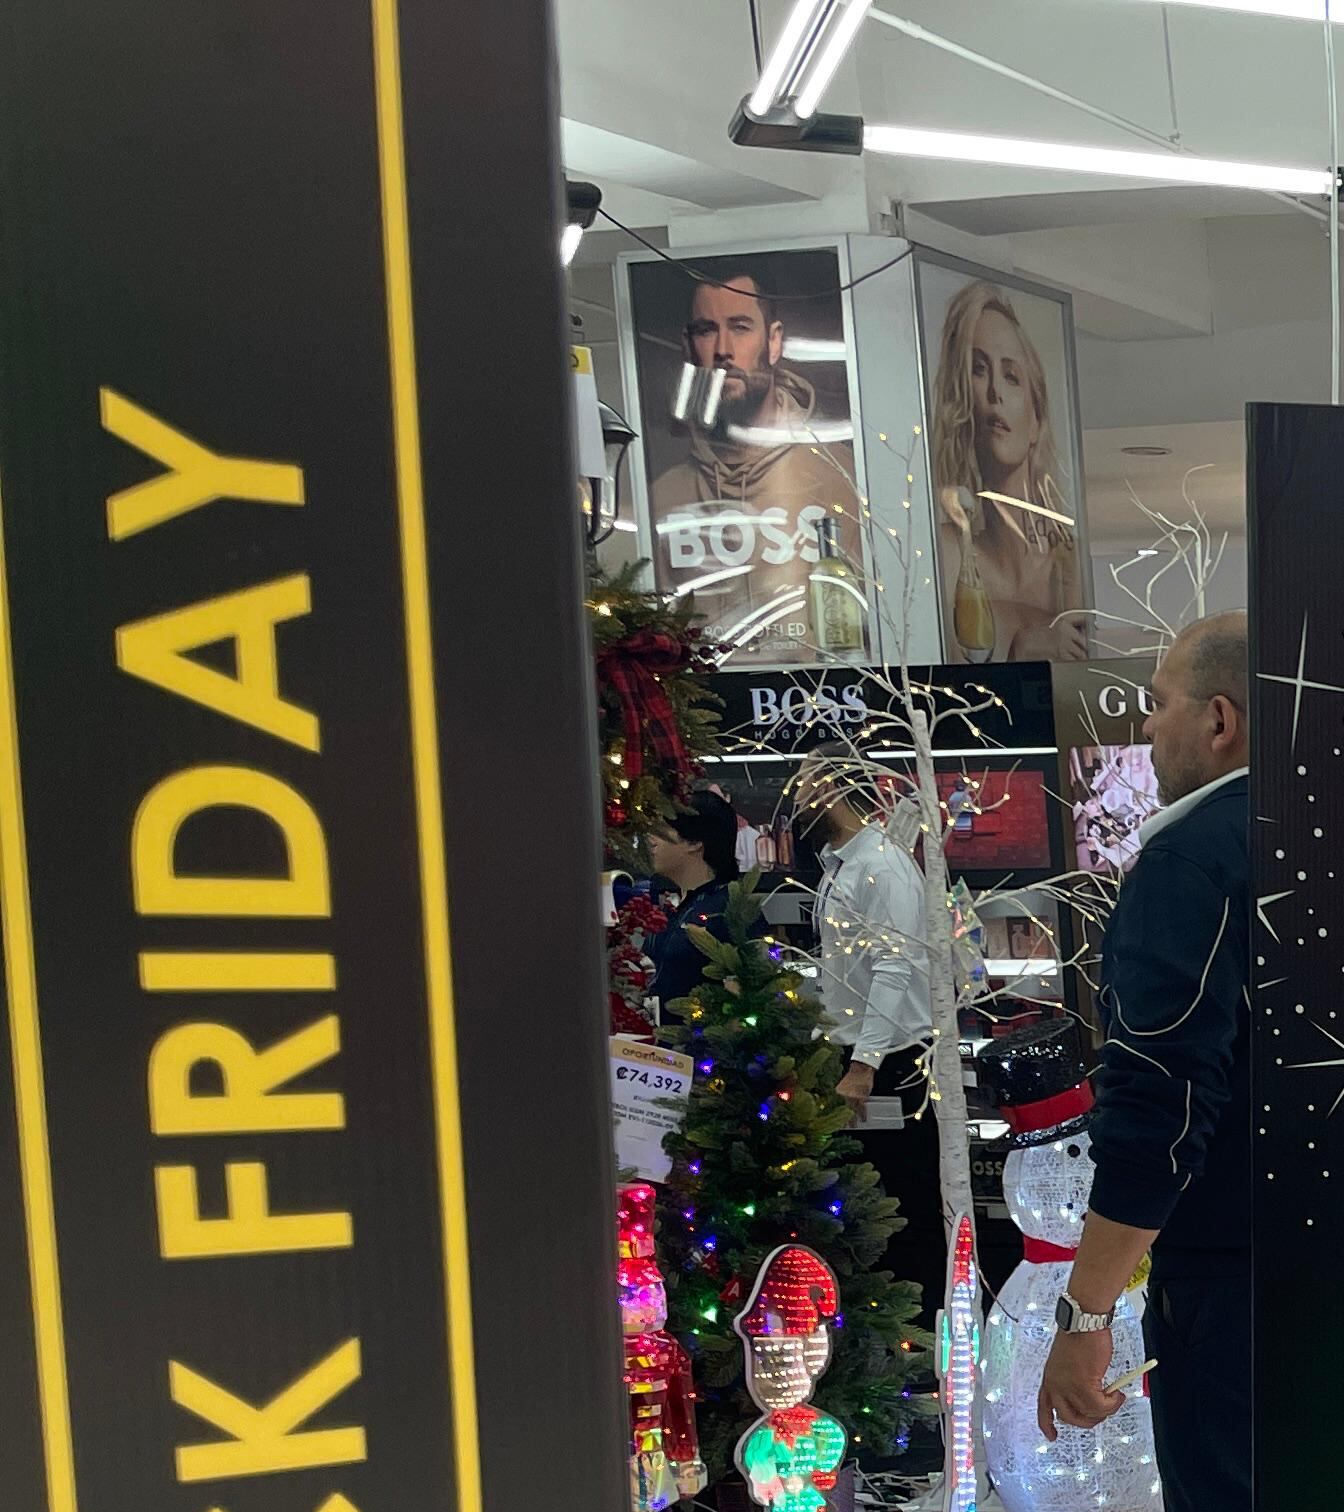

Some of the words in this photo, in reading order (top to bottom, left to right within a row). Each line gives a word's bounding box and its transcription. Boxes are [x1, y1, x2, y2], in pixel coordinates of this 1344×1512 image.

[666, 505, 827, 569] BOSS
[749, 685, 868, 725] BOSS
[99, 387, 354, 1260] FRIDAY
[972, 1160, 1003, 1177] OSS
